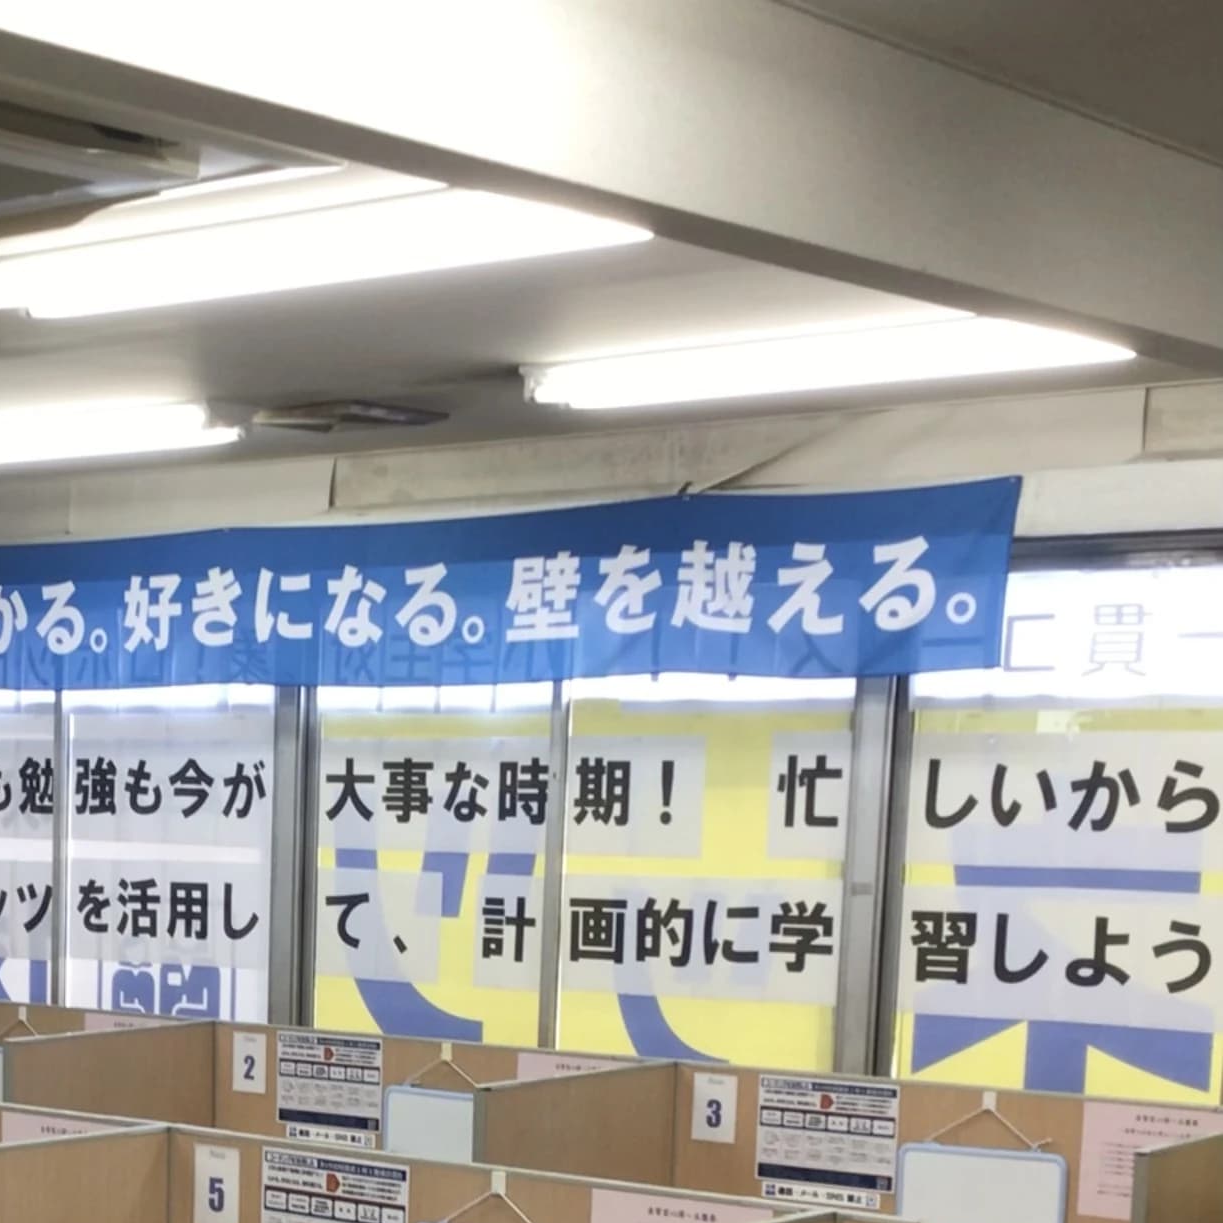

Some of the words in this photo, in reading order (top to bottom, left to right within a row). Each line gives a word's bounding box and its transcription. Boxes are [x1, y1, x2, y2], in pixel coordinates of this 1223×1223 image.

[242, 1055, 256, 1081] 2
[705, 1098, 722, 1129] 3
[208, 1177, 225, 1213] 5
